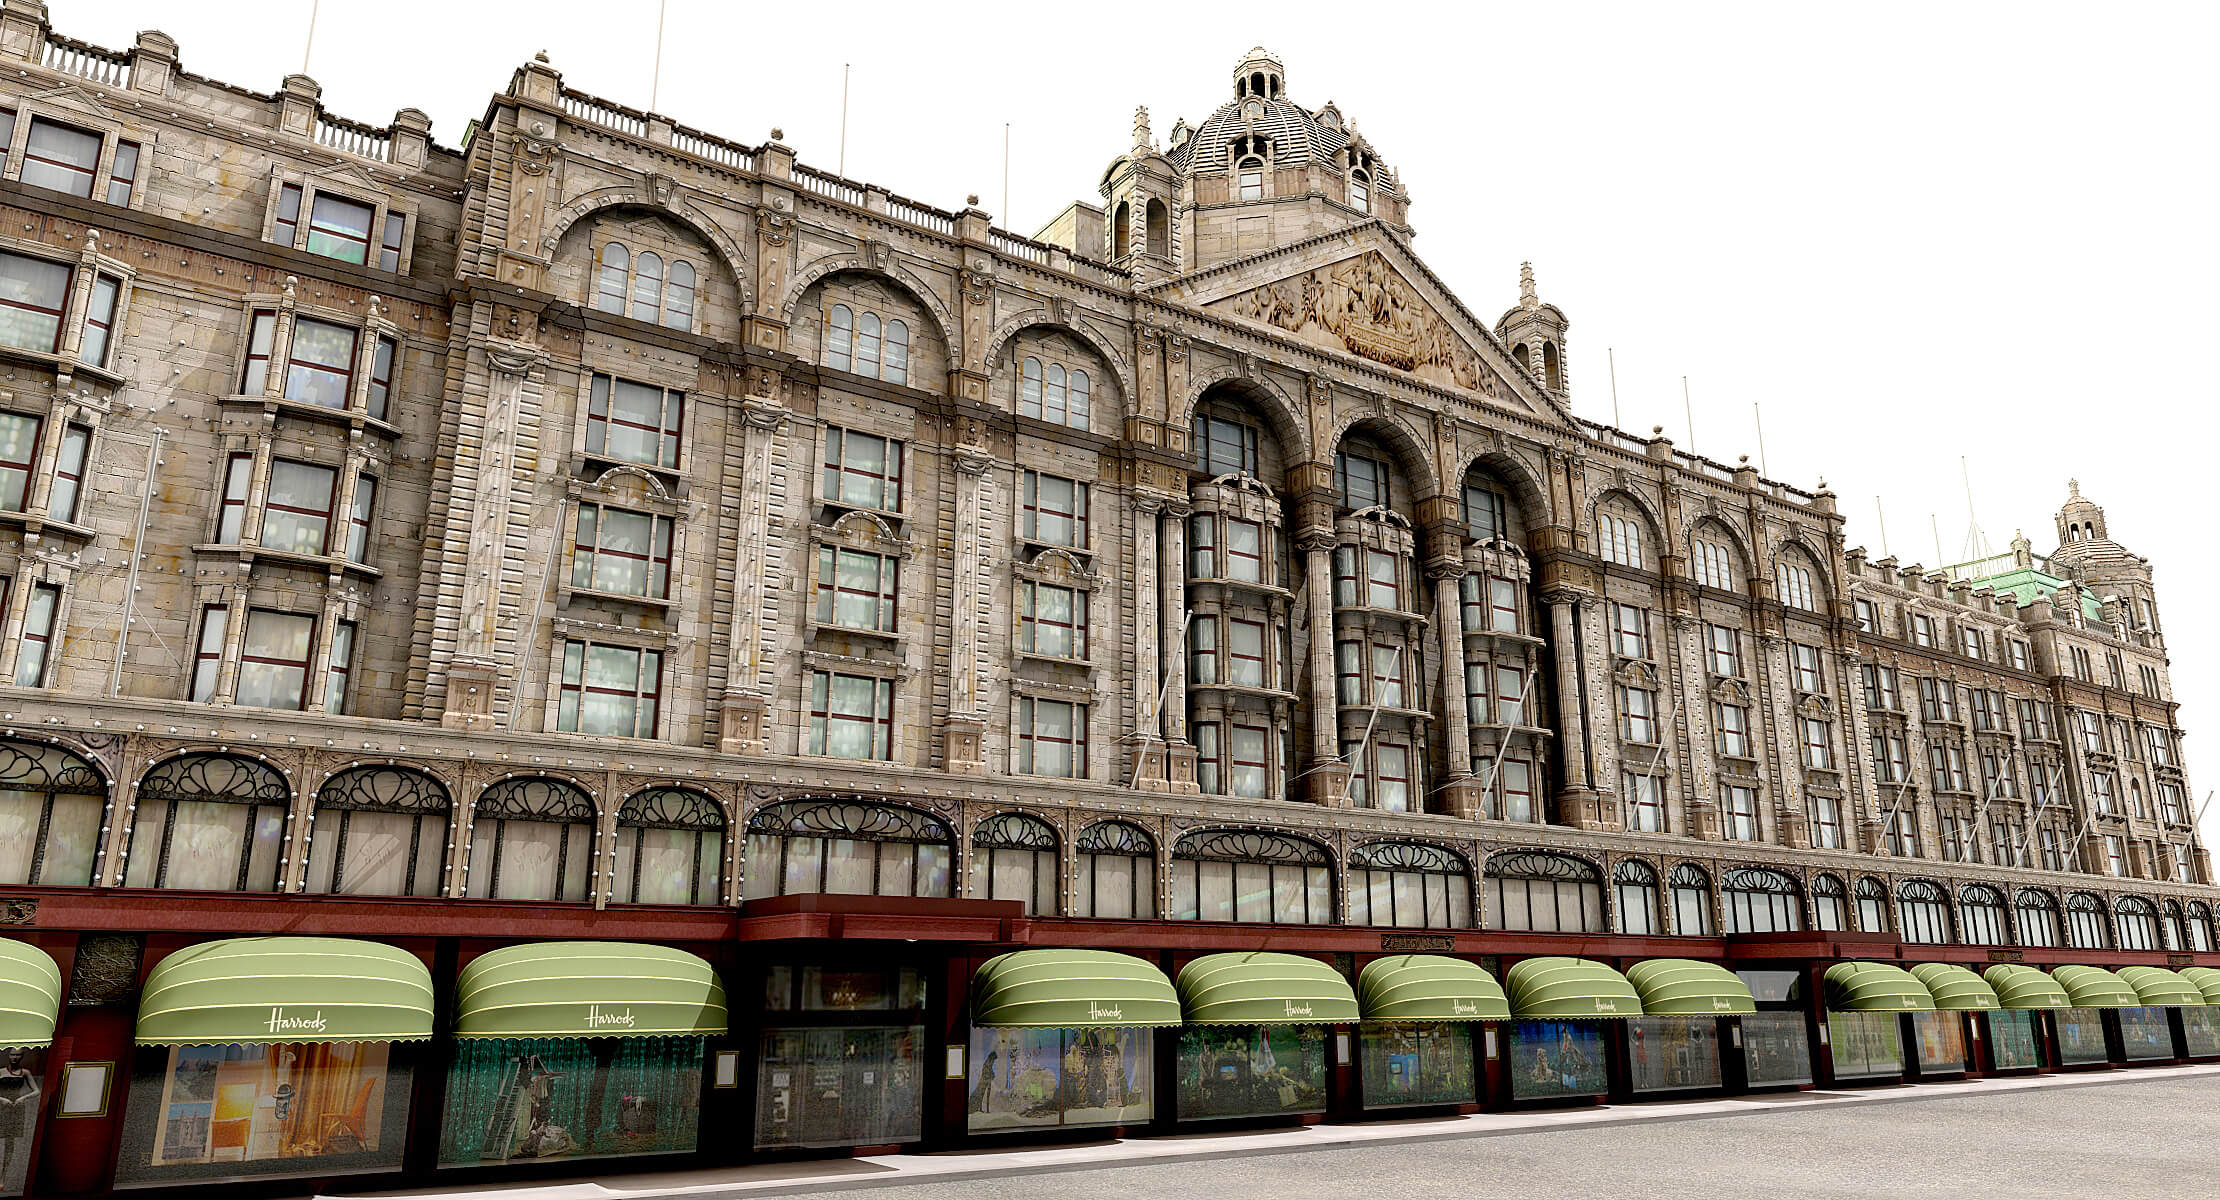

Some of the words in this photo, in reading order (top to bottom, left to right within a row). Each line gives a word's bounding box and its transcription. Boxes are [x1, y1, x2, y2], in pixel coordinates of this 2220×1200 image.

[583, 1004, 635, 1028] Harrods
[1087, 1000, 1122, 1021] Harrods
[1283, 999, 1313, 1017] Harrods
[263, 1007, 327, 1033] Harrods
